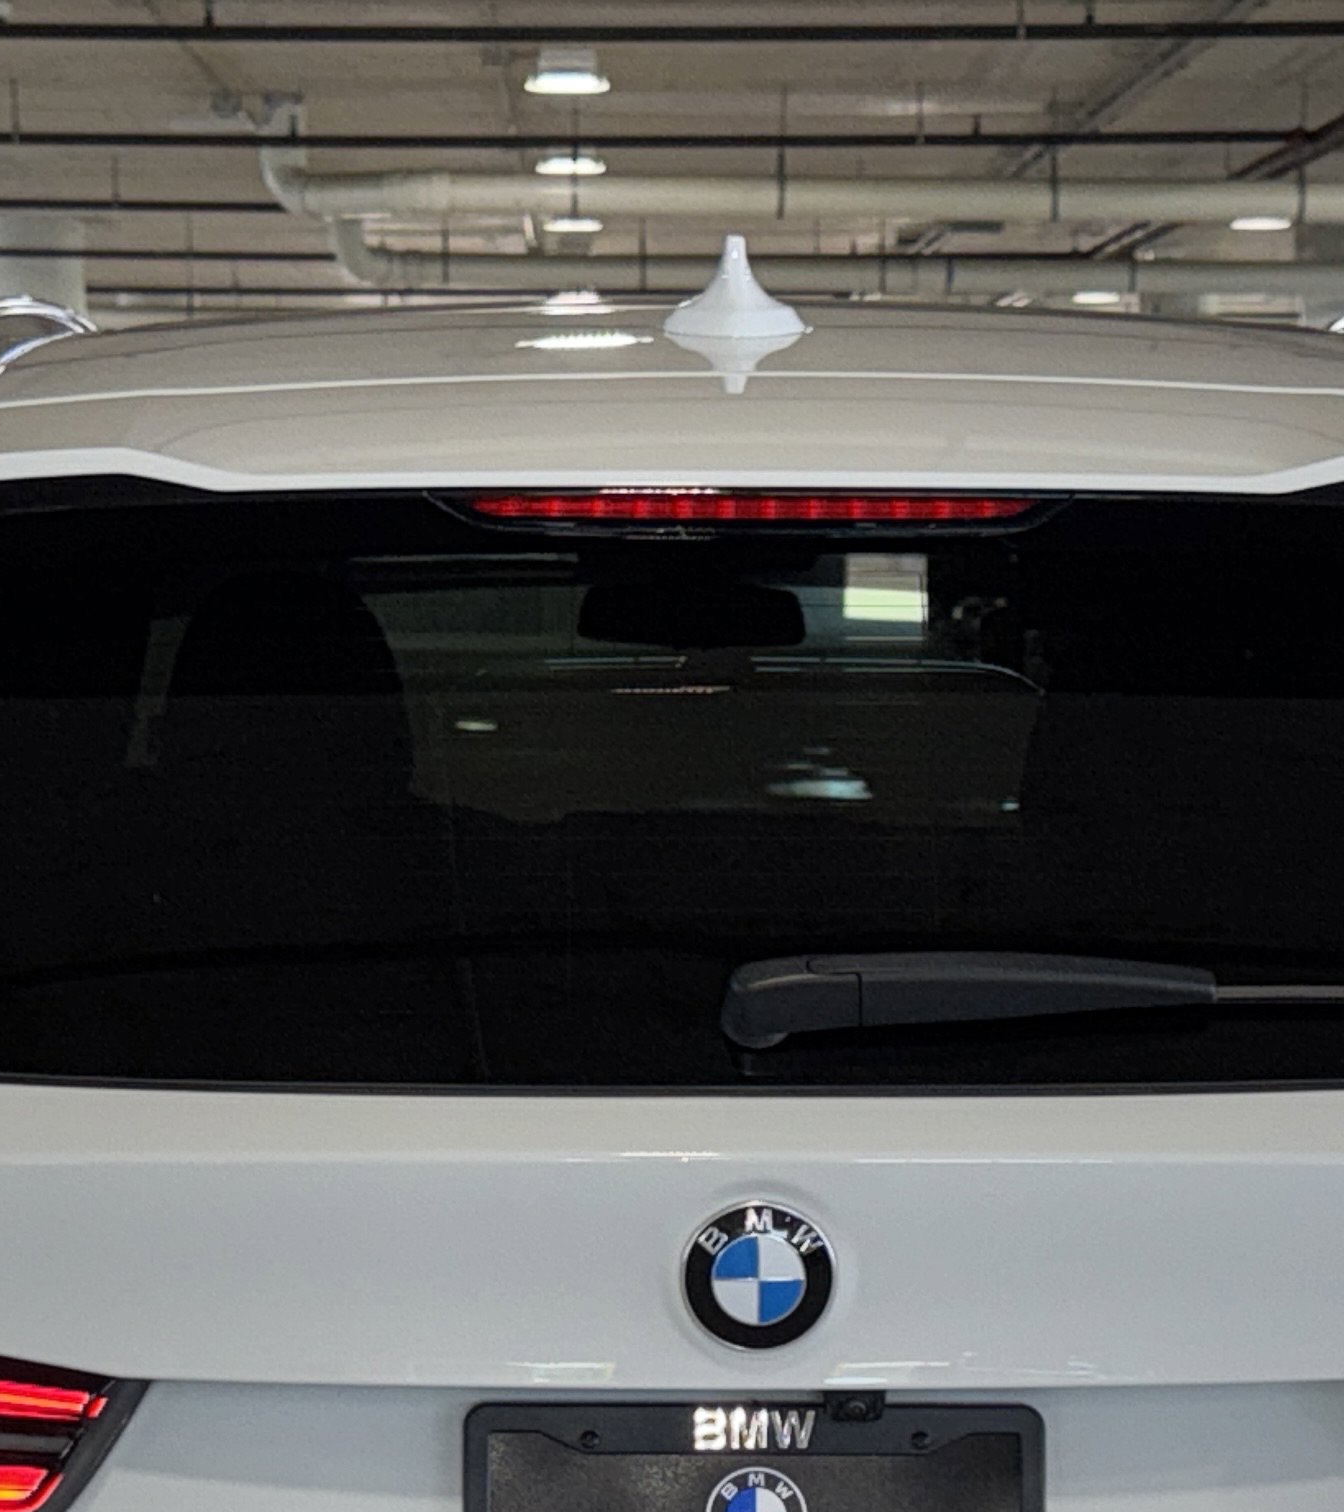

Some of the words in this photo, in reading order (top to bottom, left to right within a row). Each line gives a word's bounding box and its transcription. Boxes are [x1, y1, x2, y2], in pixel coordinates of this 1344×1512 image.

[698, 1208, 823, 1255] BMW
[693, 1406, 816, 1450] BMW
[721, 1473, 794, 1500] BMW
